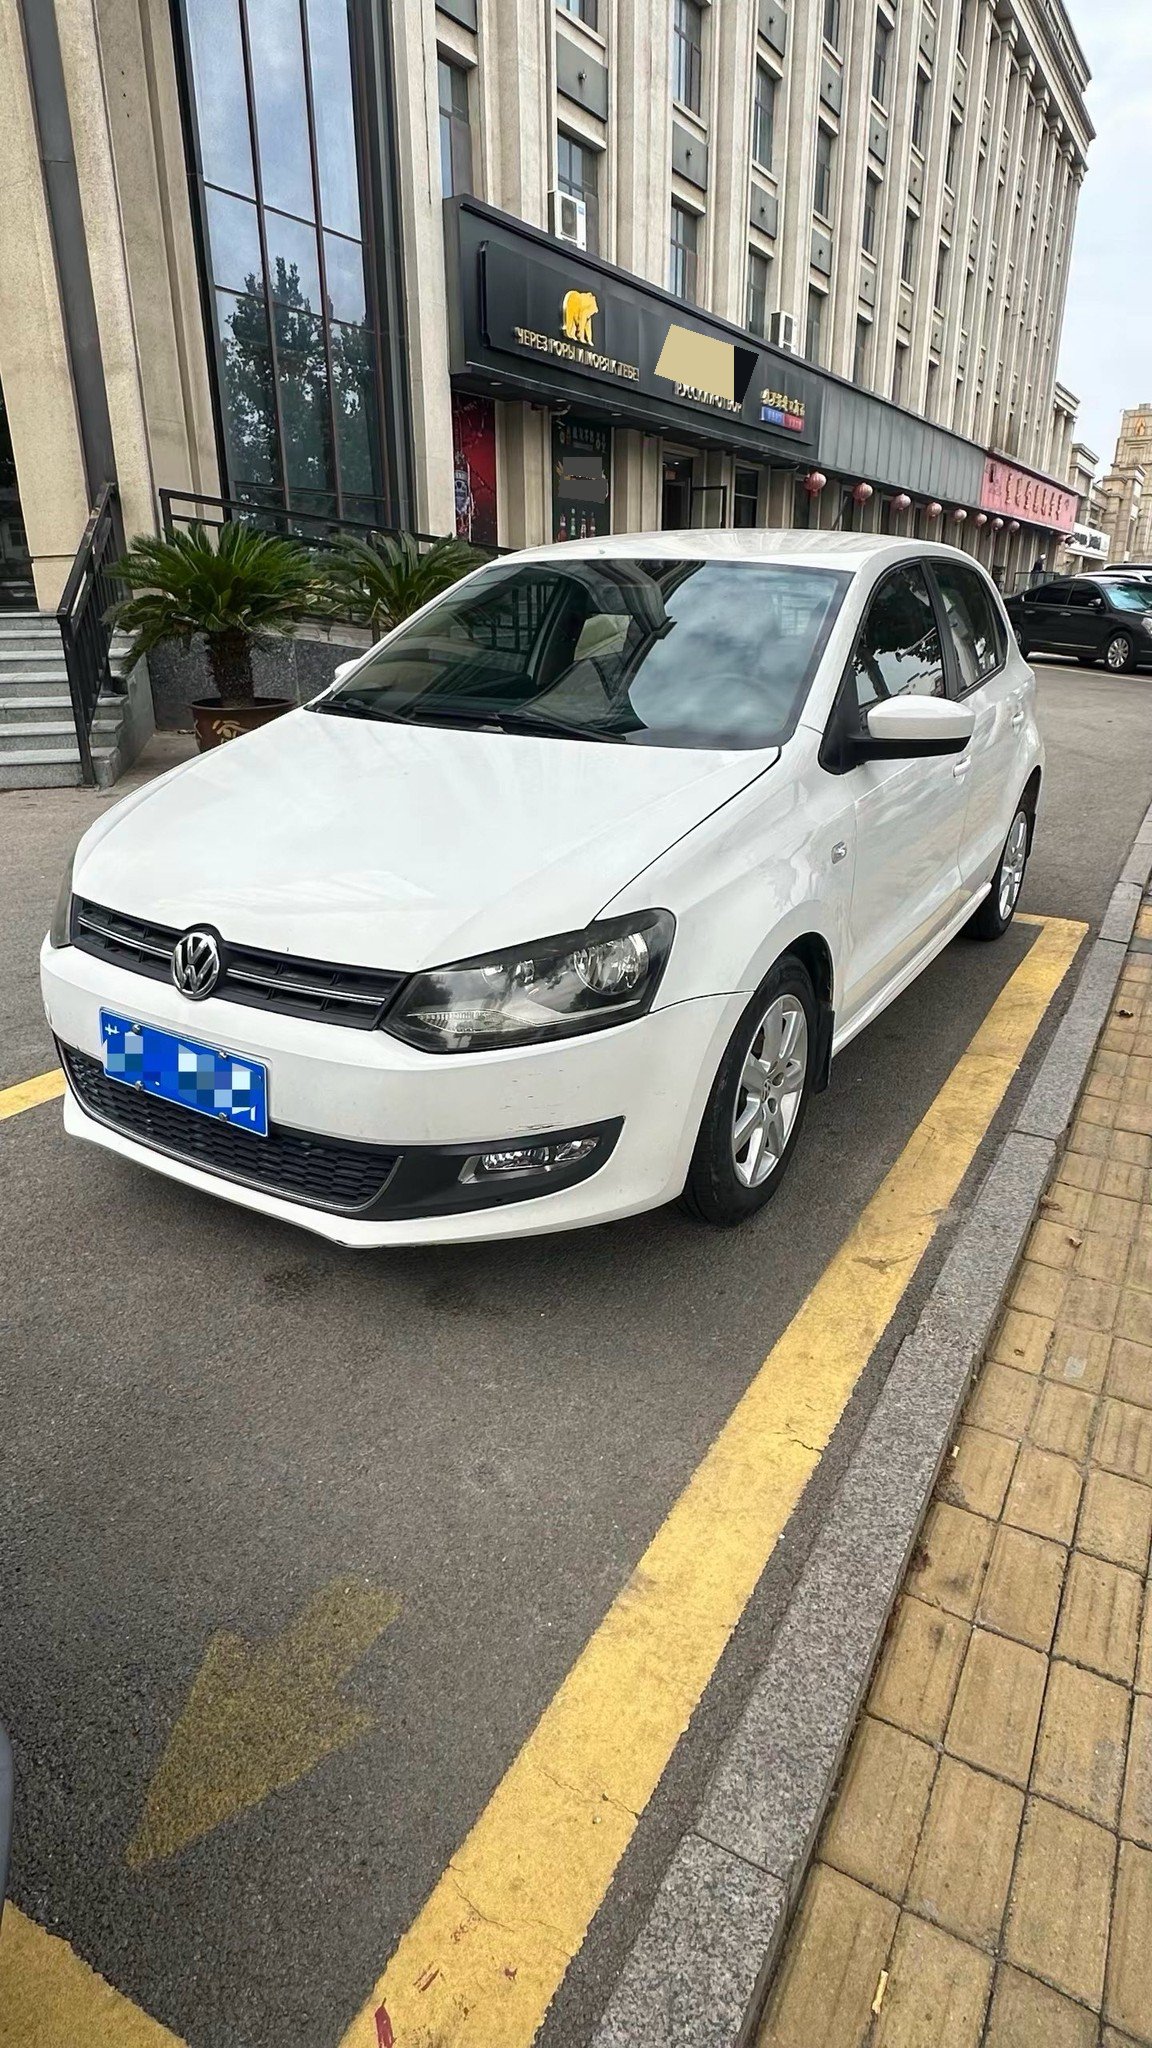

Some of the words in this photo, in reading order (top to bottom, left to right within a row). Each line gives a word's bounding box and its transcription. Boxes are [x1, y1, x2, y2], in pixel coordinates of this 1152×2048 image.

[514, 326, 547, 351] ЧЕРЕЗ
[548, 338, 576, 361] ГОРЫ
[576, 348, 584, 363] И
[584, 350, 609, 372] МОРЯ
